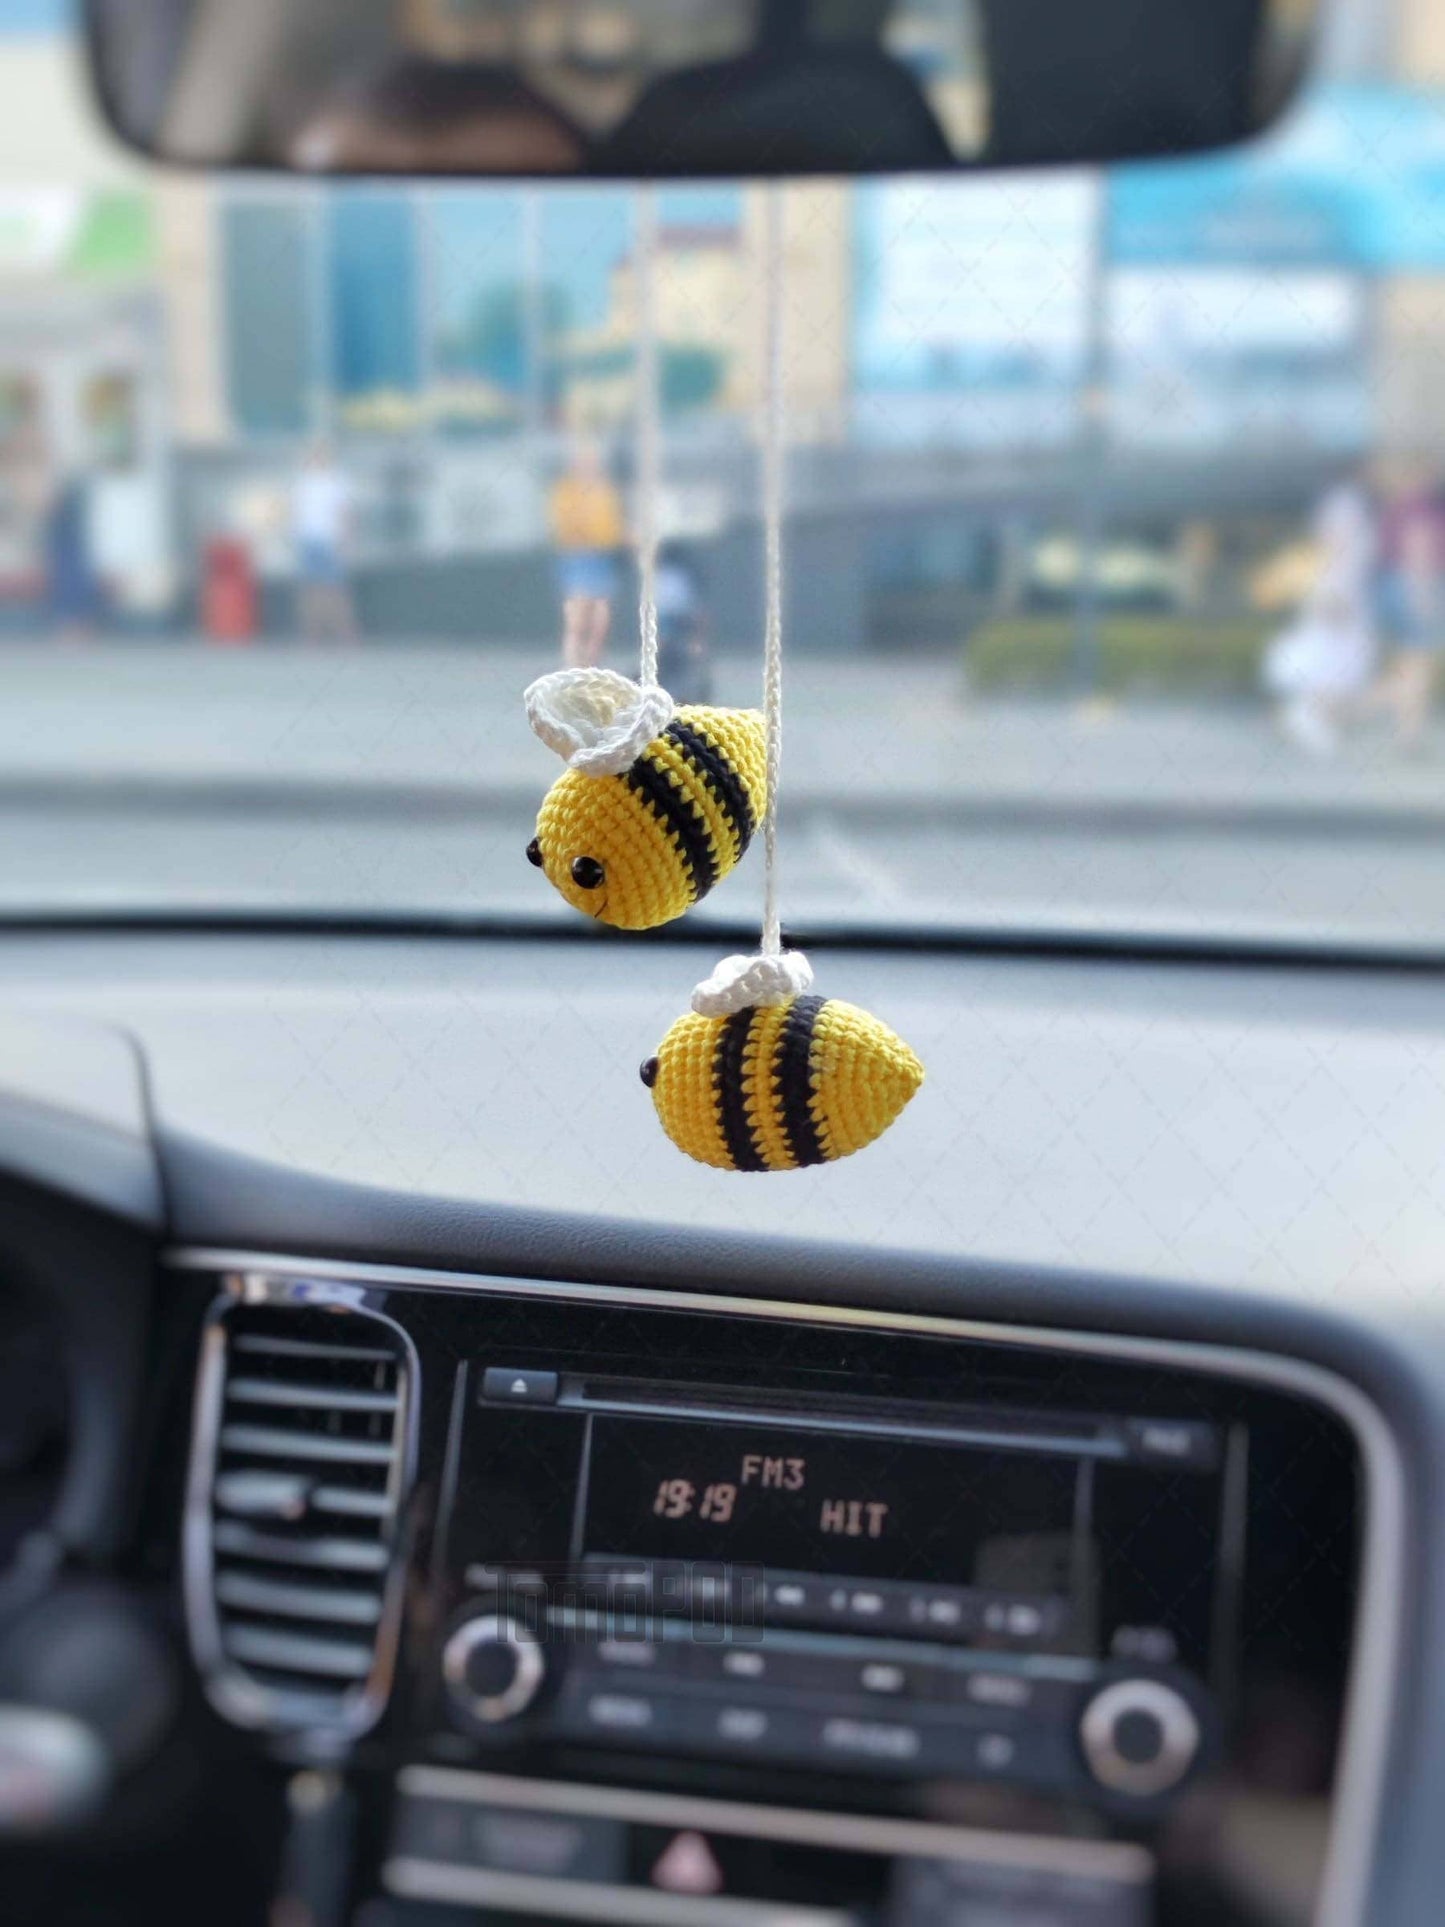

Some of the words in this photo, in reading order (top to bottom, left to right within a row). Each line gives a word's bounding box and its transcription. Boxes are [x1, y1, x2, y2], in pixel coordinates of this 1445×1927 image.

[740, 1454, 806, 1490] FM3
[652, 1478, 738, 1522] 19:19
[820, 1499, 888, 1538] HIT
